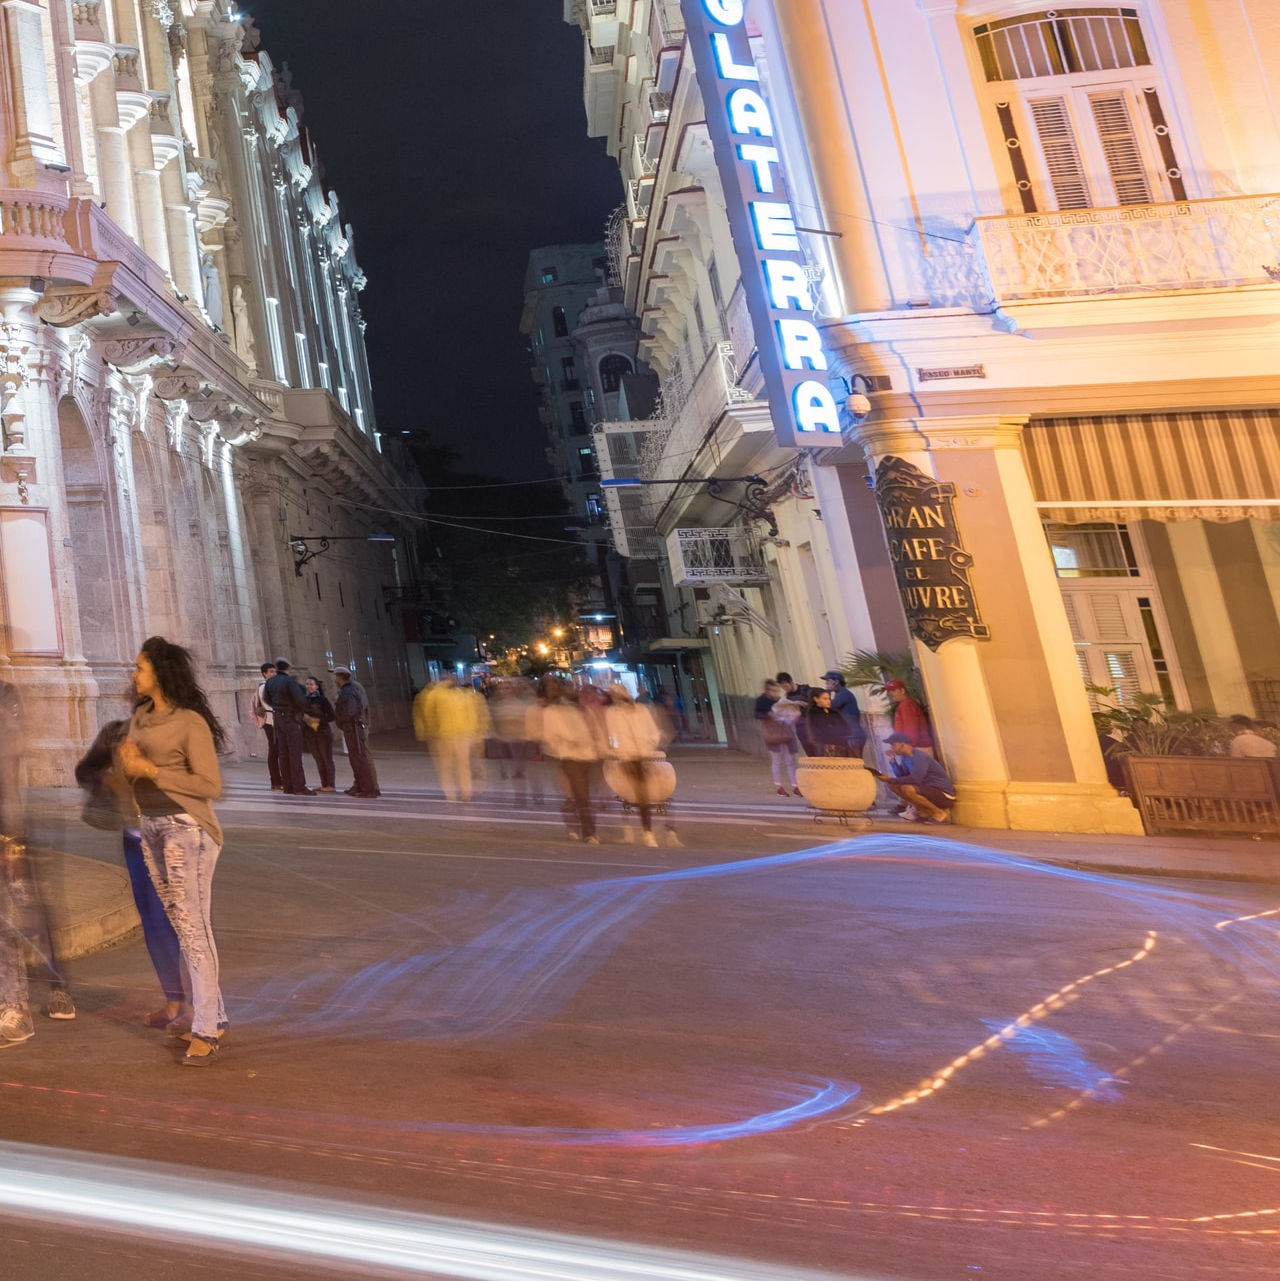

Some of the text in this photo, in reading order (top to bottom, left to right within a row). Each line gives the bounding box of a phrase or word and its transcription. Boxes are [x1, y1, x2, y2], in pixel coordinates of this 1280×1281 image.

[883, 504, 946, 529] GRAN
[891, 537, 946, 563] CAFE
[905, 566, 930, 581] EL
